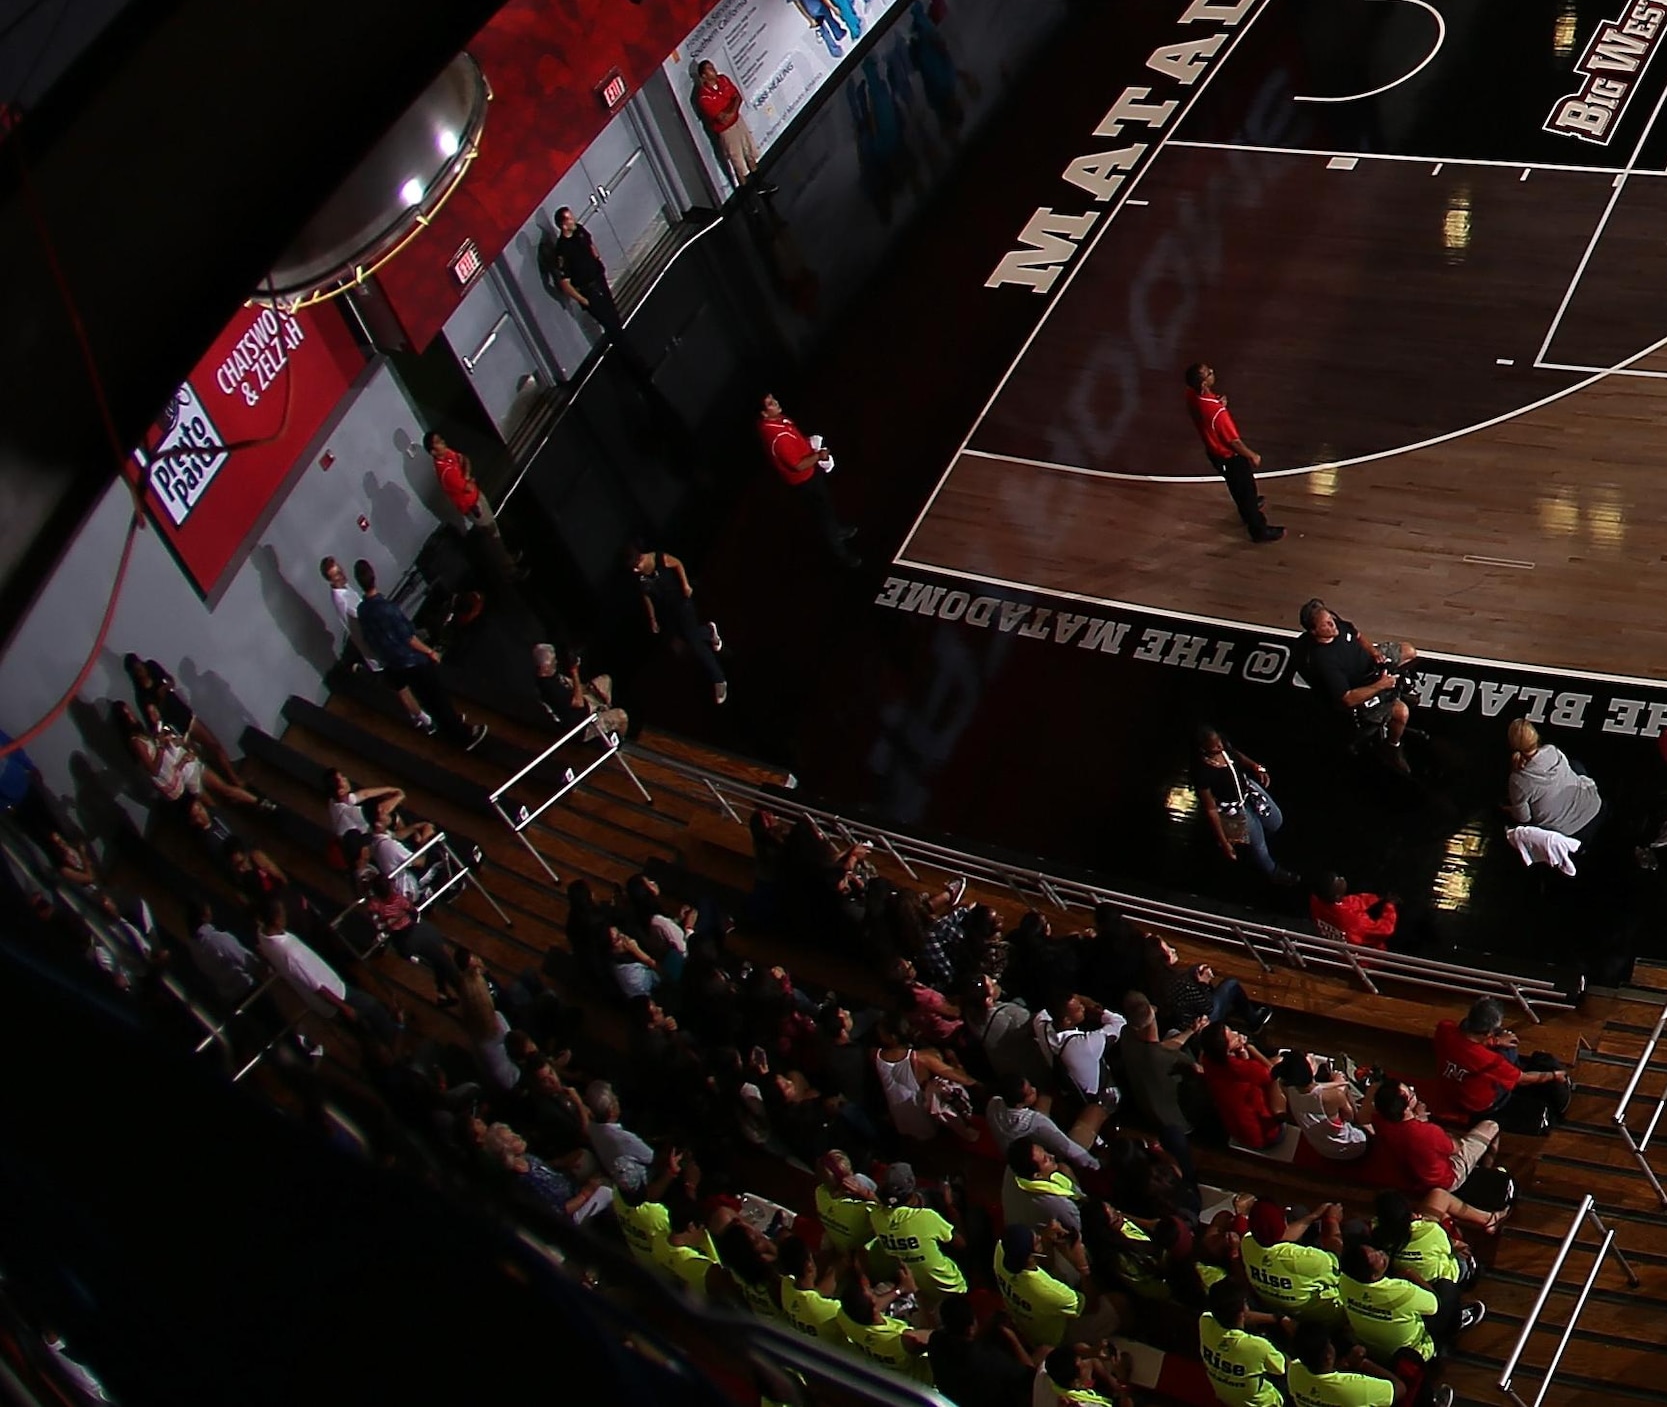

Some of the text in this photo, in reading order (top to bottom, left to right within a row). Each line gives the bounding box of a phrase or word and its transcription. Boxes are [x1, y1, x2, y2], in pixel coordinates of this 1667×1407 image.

[1555, 76, 1629, 136] BIG
[240, 381, 260, 407] &
[873, 575, 1132, 655] MATADOME
[1132, 627, 1236, 674] THE
[1242, 641, 1291, 684] @
[880, 1234, 920, 1253] Rise
[1250, 1265, 1293, 1291] Rise
[1202, 1346, 1247, 1377] Rise
